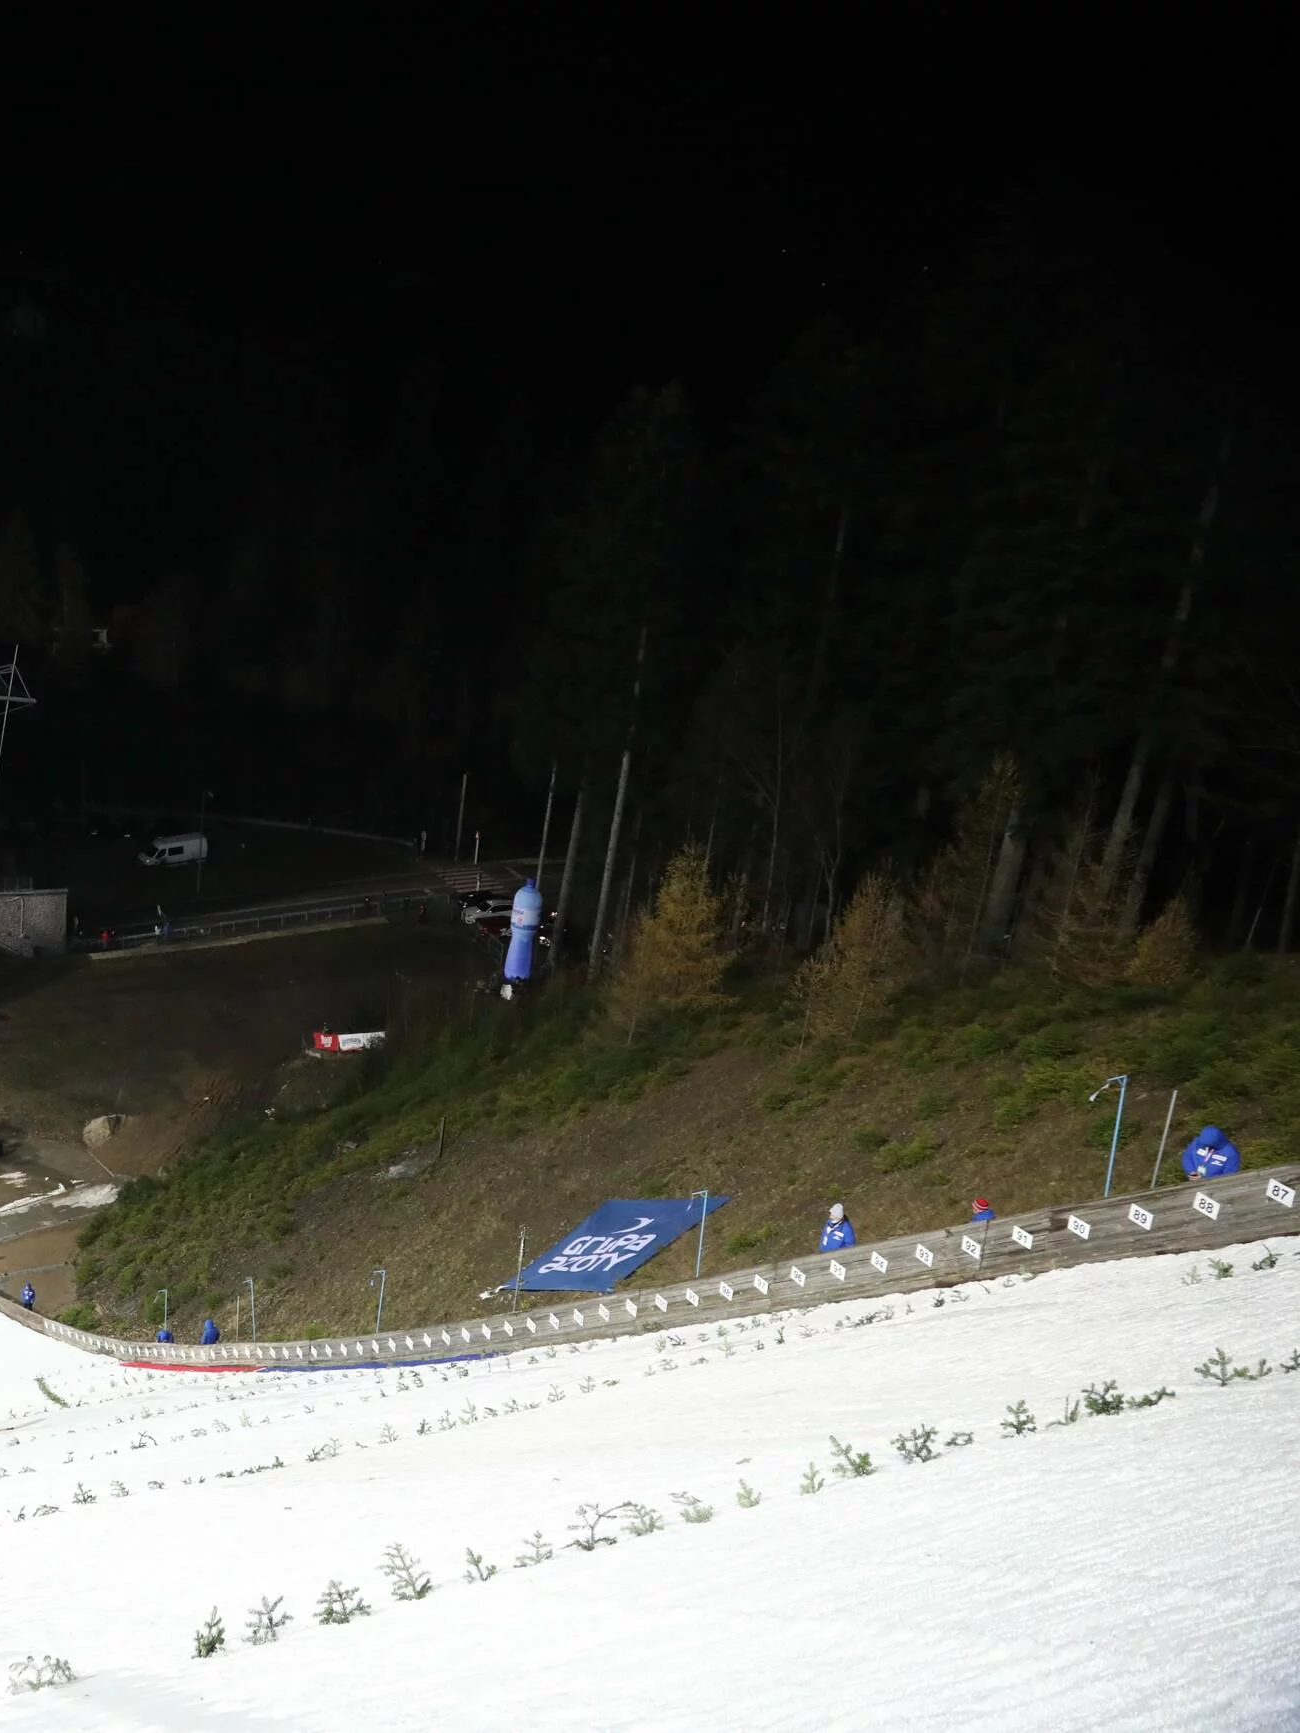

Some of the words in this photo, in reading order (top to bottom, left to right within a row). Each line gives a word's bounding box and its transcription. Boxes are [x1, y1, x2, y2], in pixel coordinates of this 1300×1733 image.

[1271, 1185, 1289, 1200] 87
[1199, 1198, 1214, 1214] 88
[1133, 1209, 1147, 1224] 89
[1072, 1220, 1086, 1234] 90
[1016, 1230, 1028, 1244] 91
[965, 1240, 977, 1253] 92
[919, 1249, 930, 1263] 93
[833, 1263, 844, 1276] 95
[874, 1257, 885, 1270] 94
[793, 1270, 803, 1282] 96
[756, 1278, 767, 1290] 97
